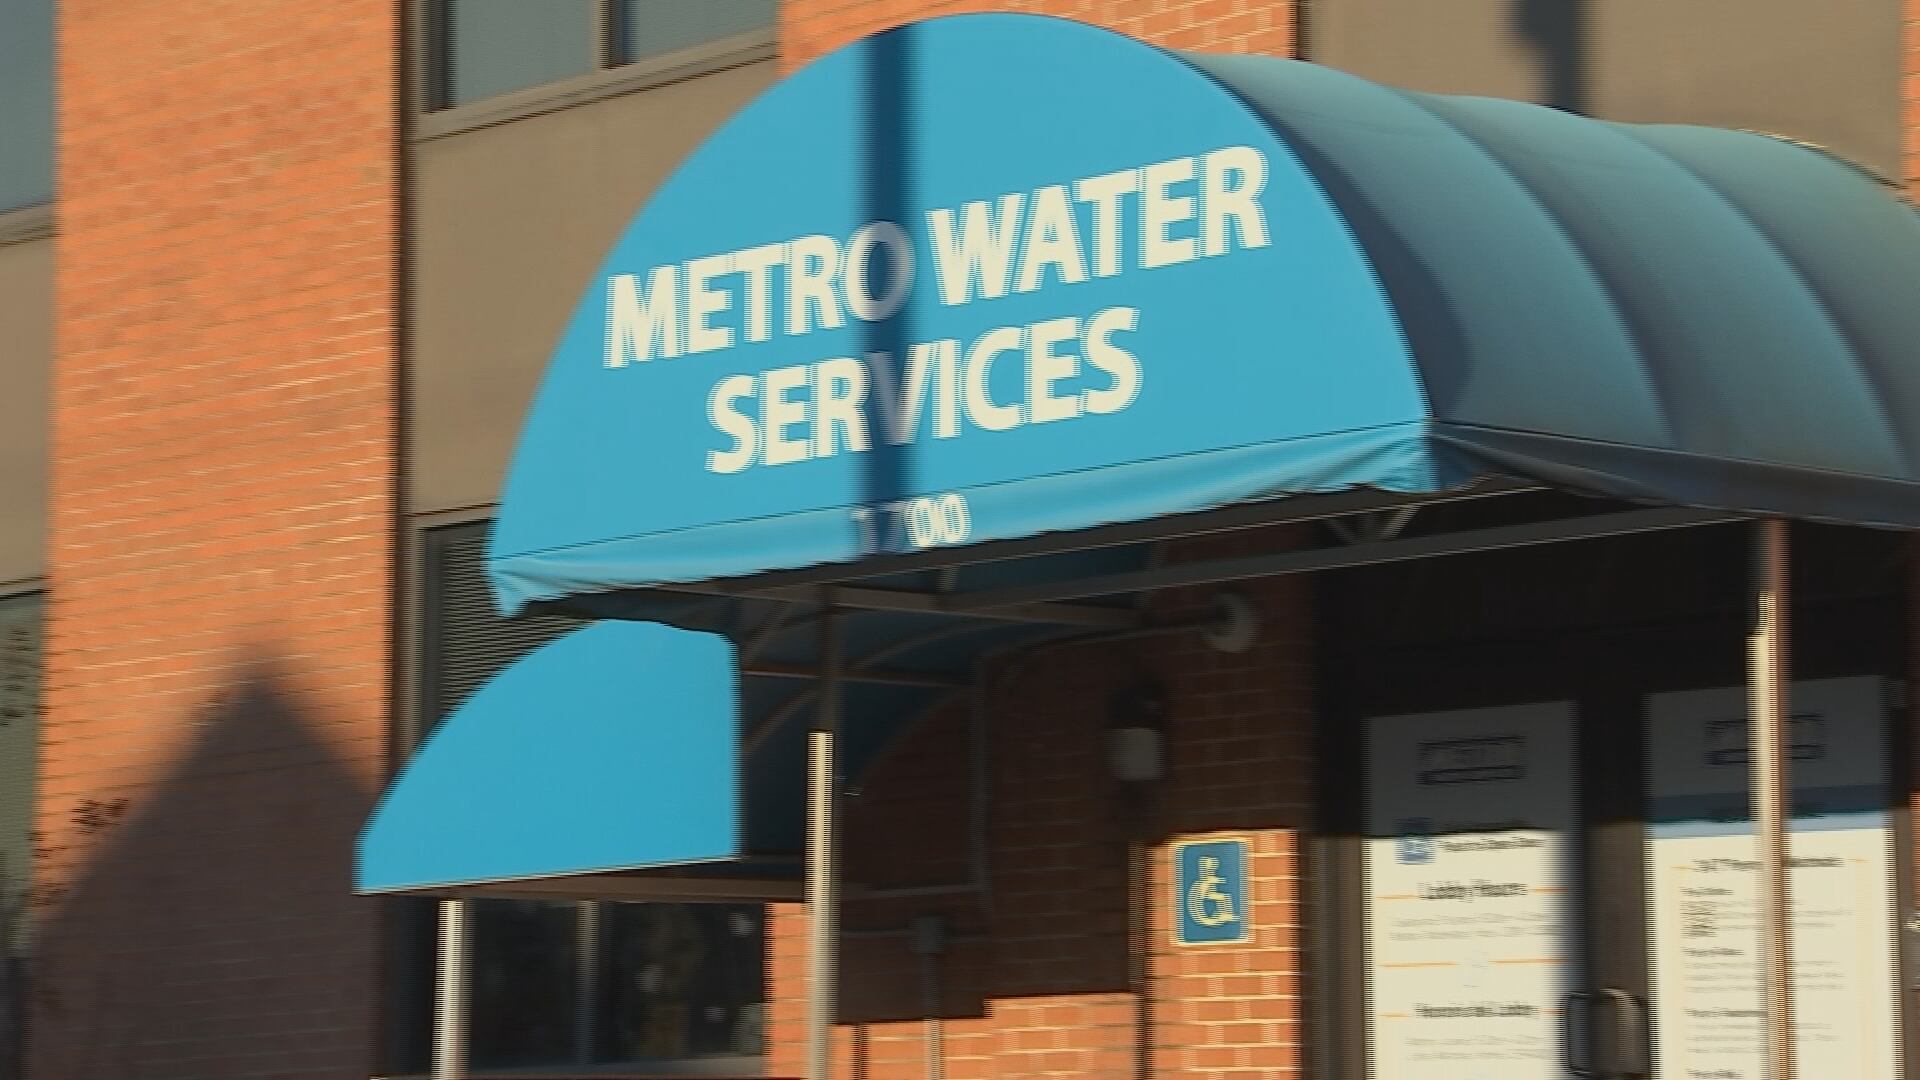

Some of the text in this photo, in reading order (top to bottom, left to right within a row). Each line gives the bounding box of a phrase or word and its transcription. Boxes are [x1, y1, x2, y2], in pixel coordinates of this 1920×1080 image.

[604, 146, 1272, 368] METRO WATER
[704, 307, 1143, 475] SERVICES
[850, 493, 972, 553] 1700
